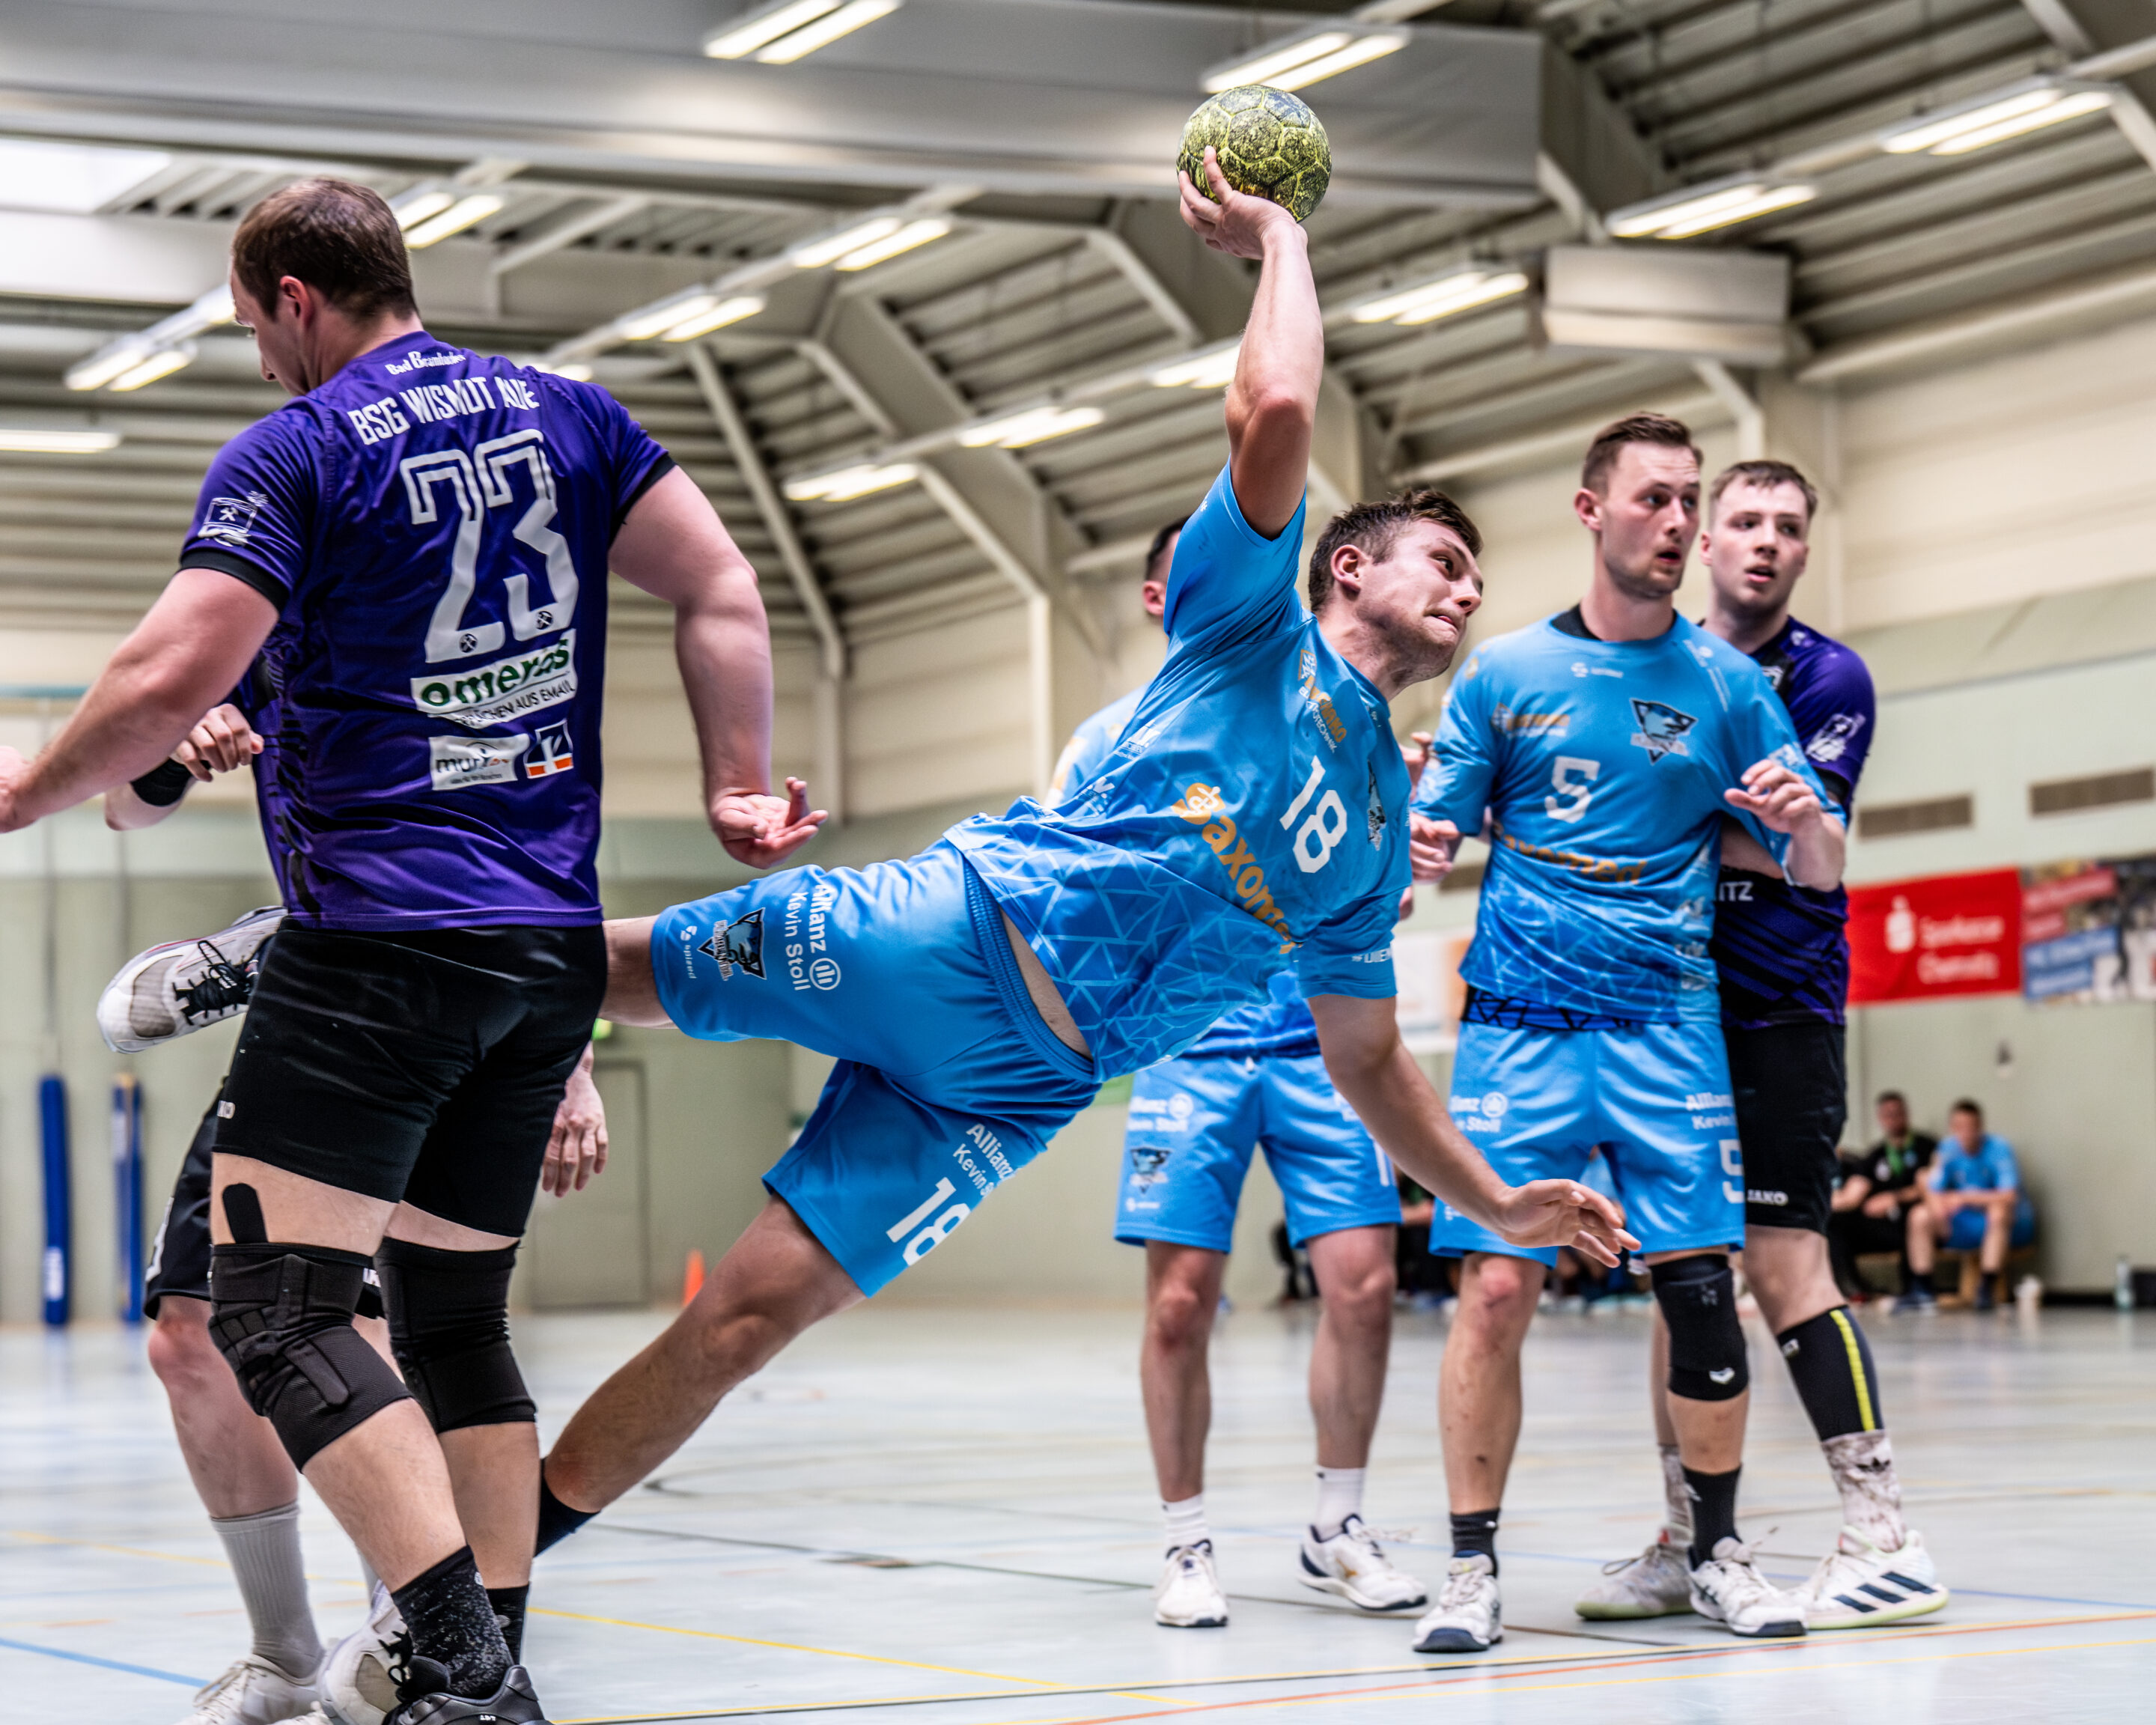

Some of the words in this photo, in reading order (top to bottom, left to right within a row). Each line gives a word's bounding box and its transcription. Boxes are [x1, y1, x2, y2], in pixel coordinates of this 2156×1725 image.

[384, 359, 414, 375] Bad
[347, 396, 411, 445] BSG
[399, 376, 496, 424] WISMUT
[493, 376, 540, 410] AUE
[399, 428, 579, 664] 23
[515, 691, 540, 710] AUS
[539, 678, 576, 702] EMAIL
[1279, 755, 1348, 874] 18
[1544, 755, 1601, 824] 5
[785, 892, 809, 937] Kevin
[808, 883, 834, 954] Allianz
[785, 943, 811, 991] Stoll
[952, 1143, 988, 1190] Kevin
[886, 1176, 972, 1267] 18
